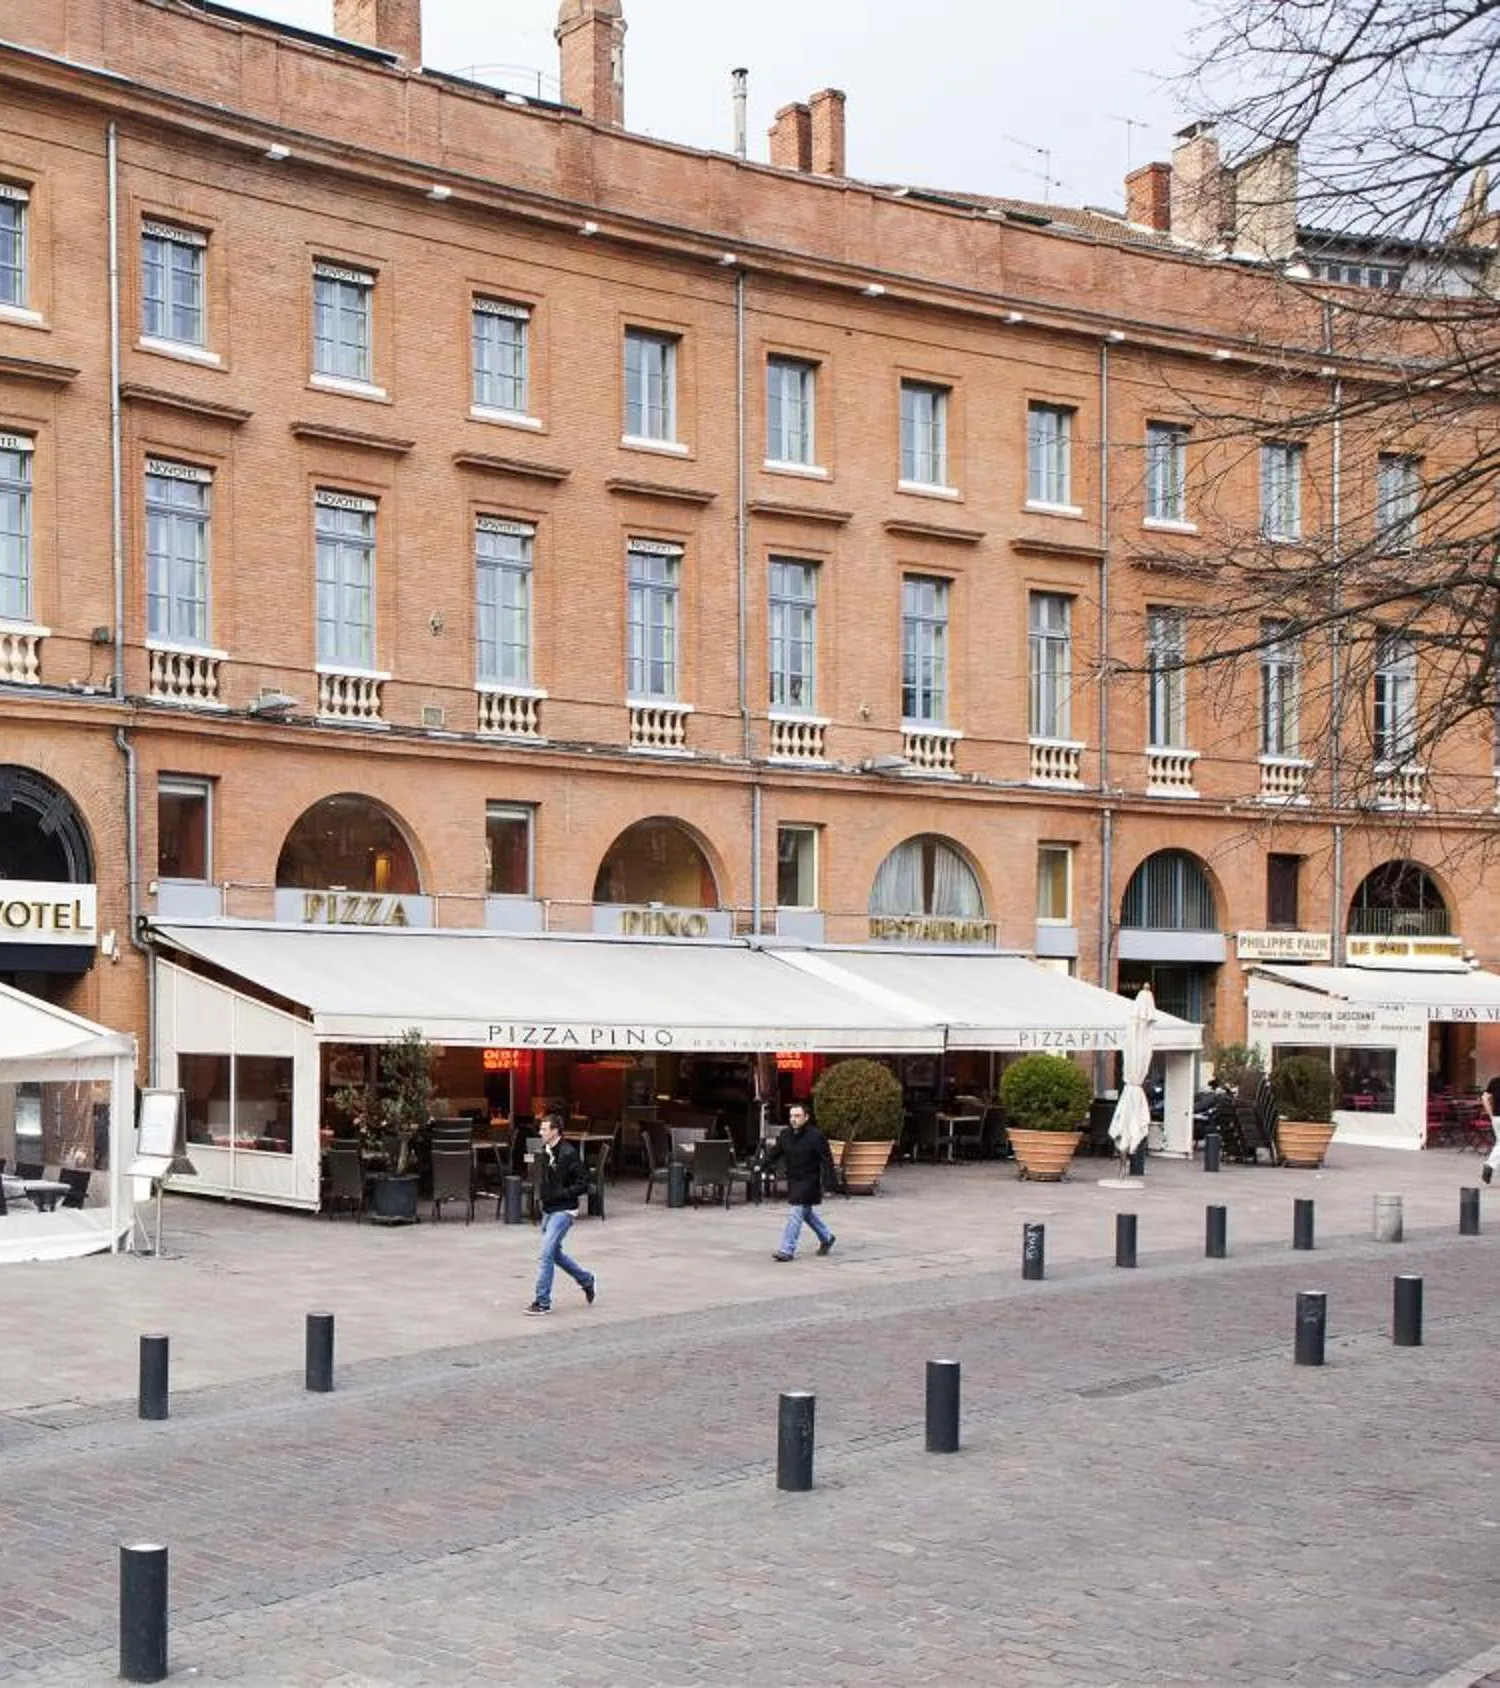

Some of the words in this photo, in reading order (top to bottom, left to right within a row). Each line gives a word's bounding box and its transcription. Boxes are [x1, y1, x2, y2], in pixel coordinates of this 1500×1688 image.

[149, 460, 200, 481] NOVOTEL
[303, 892, 409, 926] PIZZA
[618, 909, 709, 937] PINO
[1240, 936, 1293, 949] PHILIPPE
[488, 1025, 579, 1045] PIZZA
[591, 1028, 674, 1047] PINO
[1018, 1031, 1074, 1047] PIZZA
[1080, 1031, 1119, 1047] PIN
